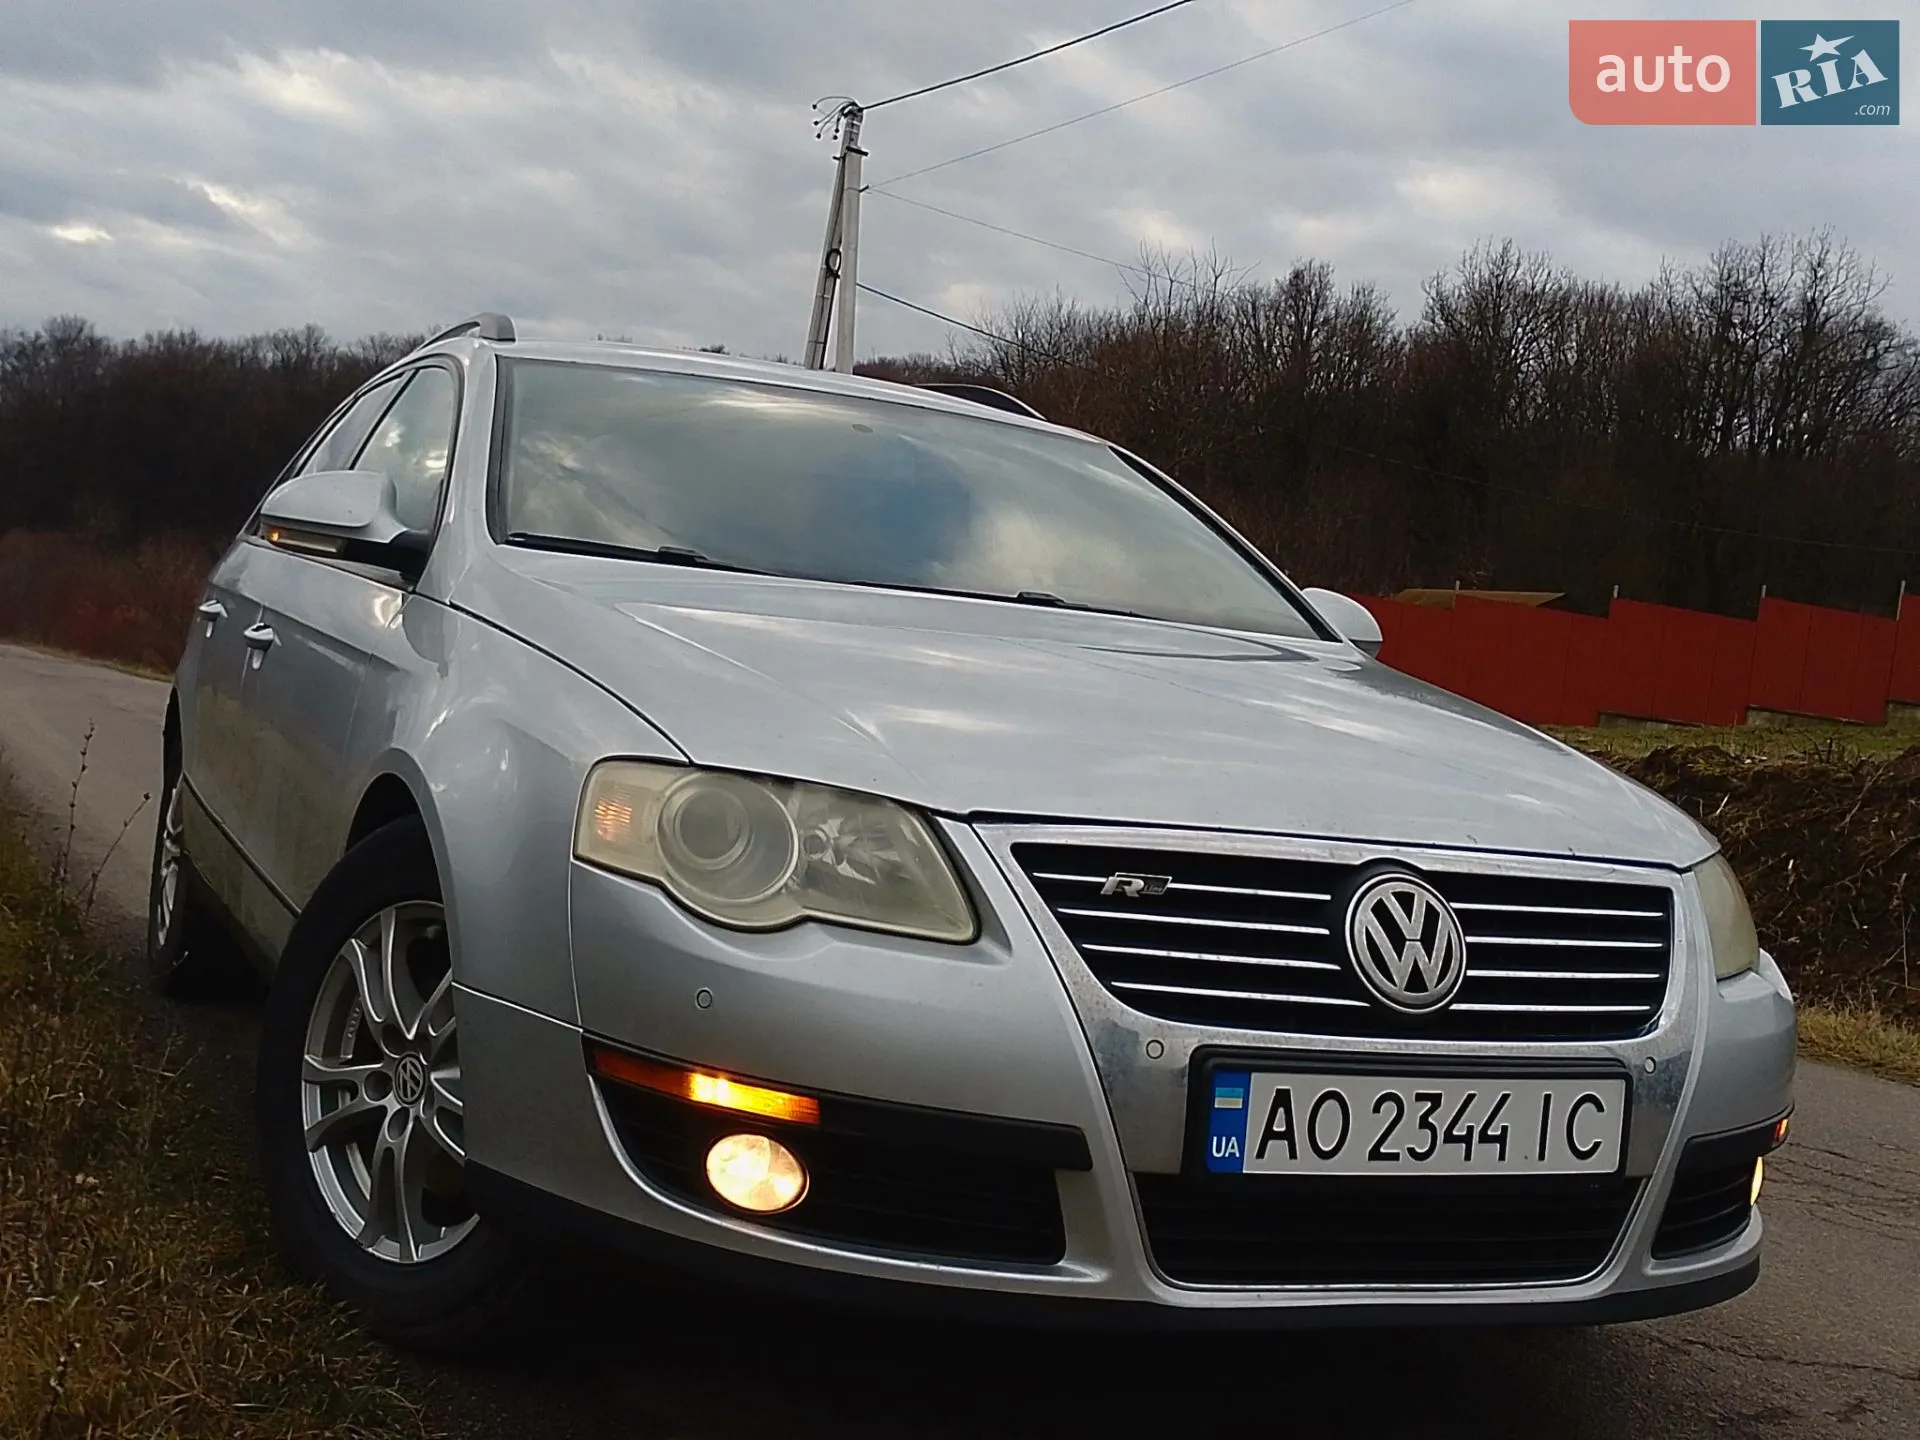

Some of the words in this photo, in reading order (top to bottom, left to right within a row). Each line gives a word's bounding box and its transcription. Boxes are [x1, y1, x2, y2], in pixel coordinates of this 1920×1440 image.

[1354, 881, 1460, 1004] VW
[1212, 1136, 1240, 1158] UA
[1254, 1086, 1351, 1161] AO
[1367, 1090, 1511, 1162] 2344
[1536, 1092, 1606, 1162] IC
